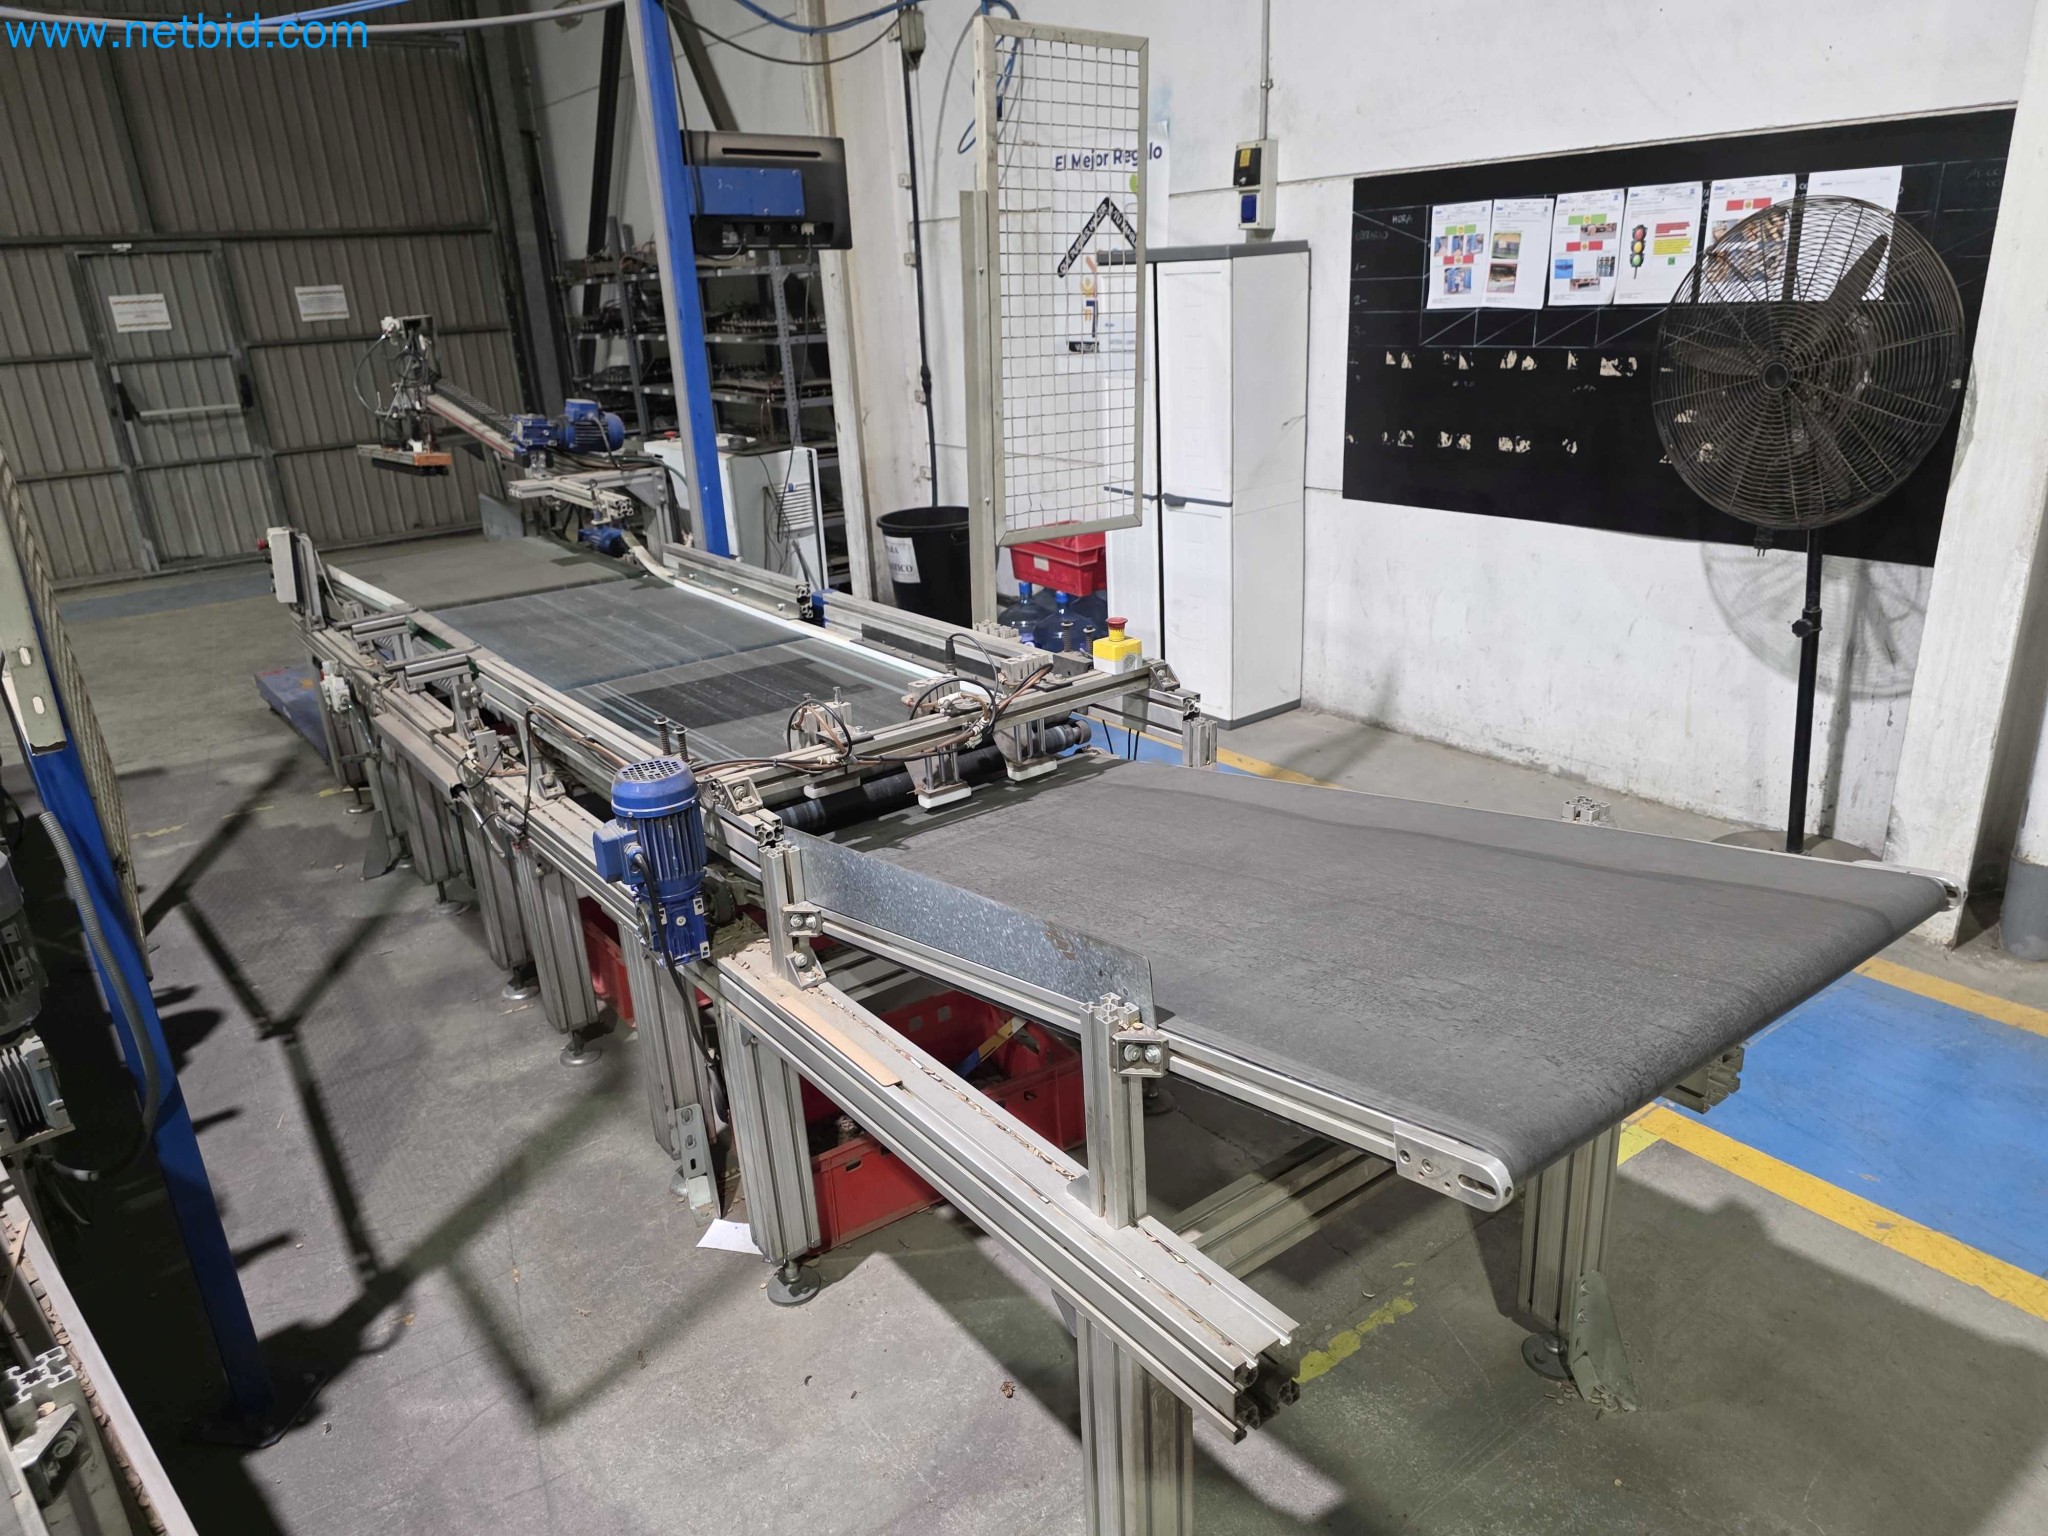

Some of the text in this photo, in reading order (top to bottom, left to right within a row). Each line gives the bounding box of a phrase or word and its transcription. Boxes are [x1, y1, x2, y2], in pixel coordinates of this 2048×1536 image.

[1071, 148, 1109, 171] Mejor
[1113, 141, 1163, 167] Reglo
[1392, 213, 1413, 225] HORA
